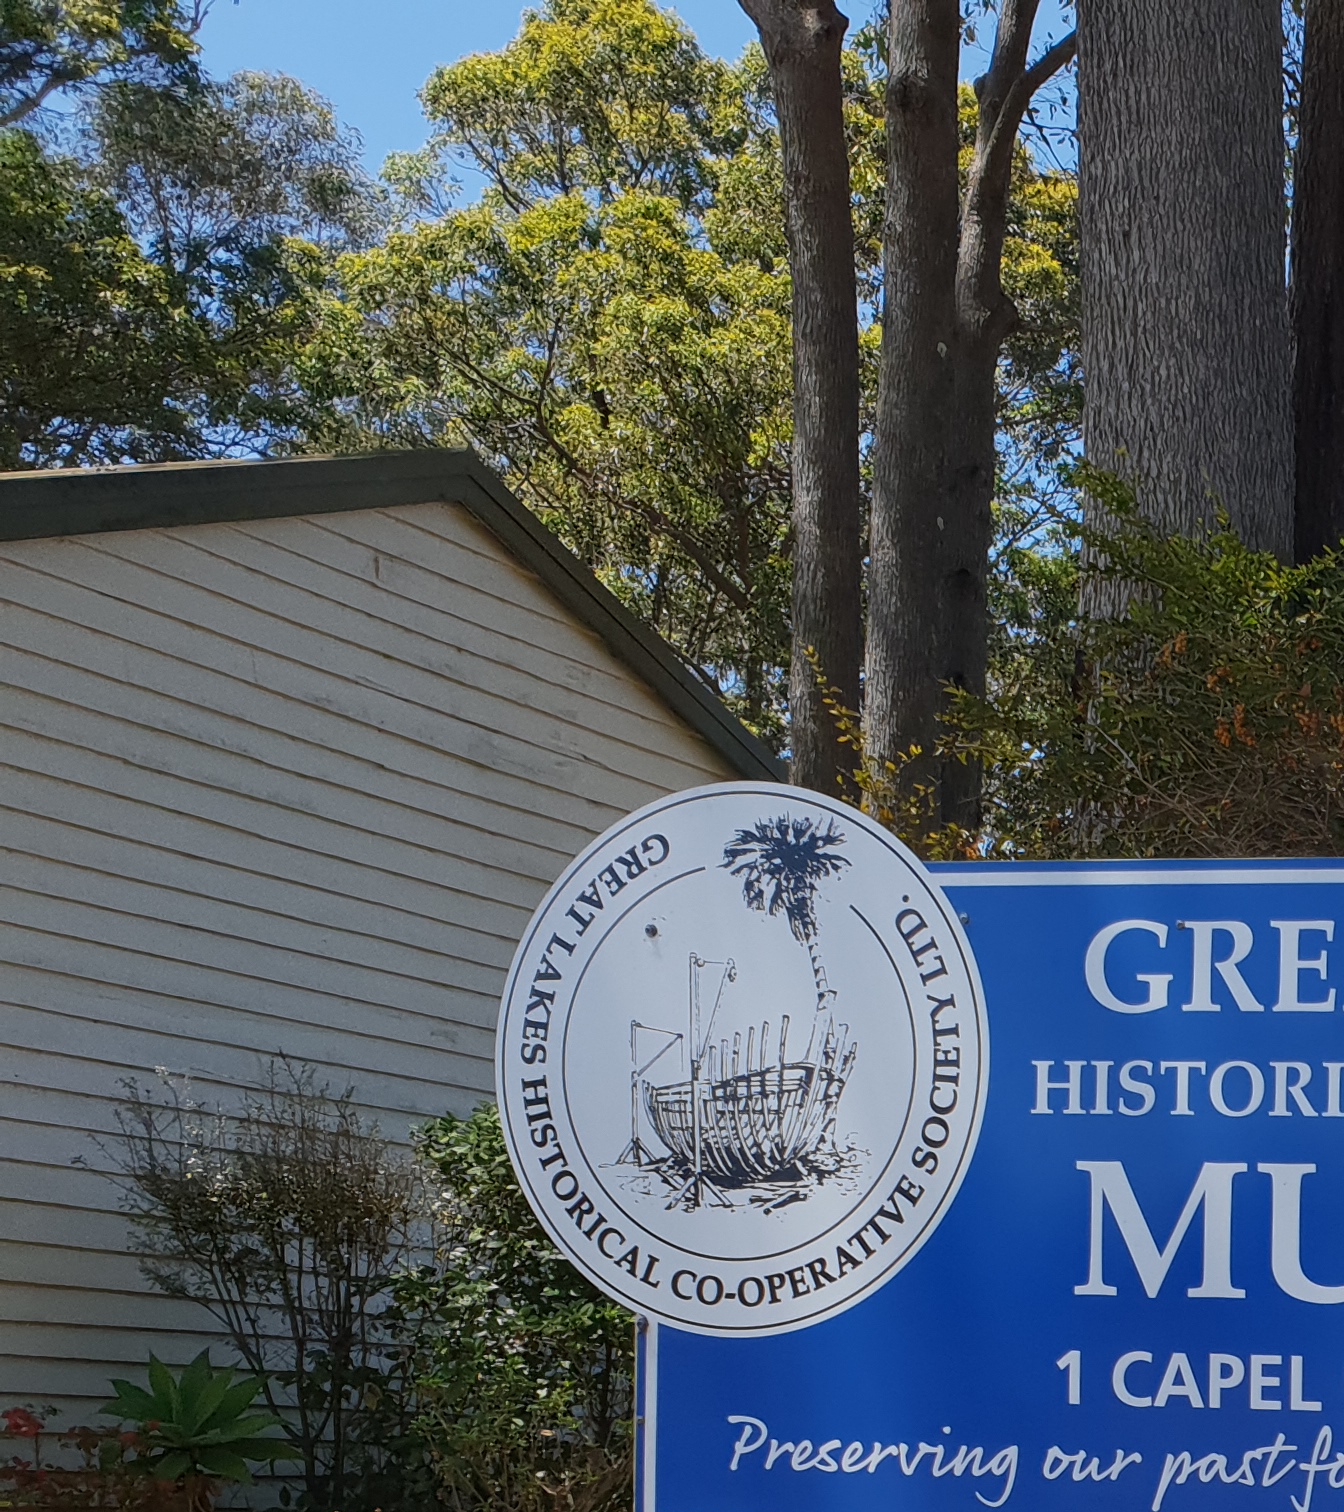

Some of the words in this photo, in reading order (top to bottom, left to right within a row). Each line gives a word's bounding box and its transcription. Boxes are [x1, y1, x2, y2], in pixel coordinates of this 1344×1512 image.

[564, 832, 671, 936] GREAT
[519, 932, 576, 1064] LAKES
[911, 994, 961, 1176] SOCIETY
[520, 1075, 661, 1288] HISTORICAL
[671, 1174, 925, 1307] CO-OPERATIVE
[1056, 1350, 1082, 1406] 1
[1112, 1350, 1322, 1413] CAPEL
[727, 1415, 1019, 1507] Preserving
[1042, 1445, 1142, 1482] our
[1150, 1432, 1298, 1512] past
